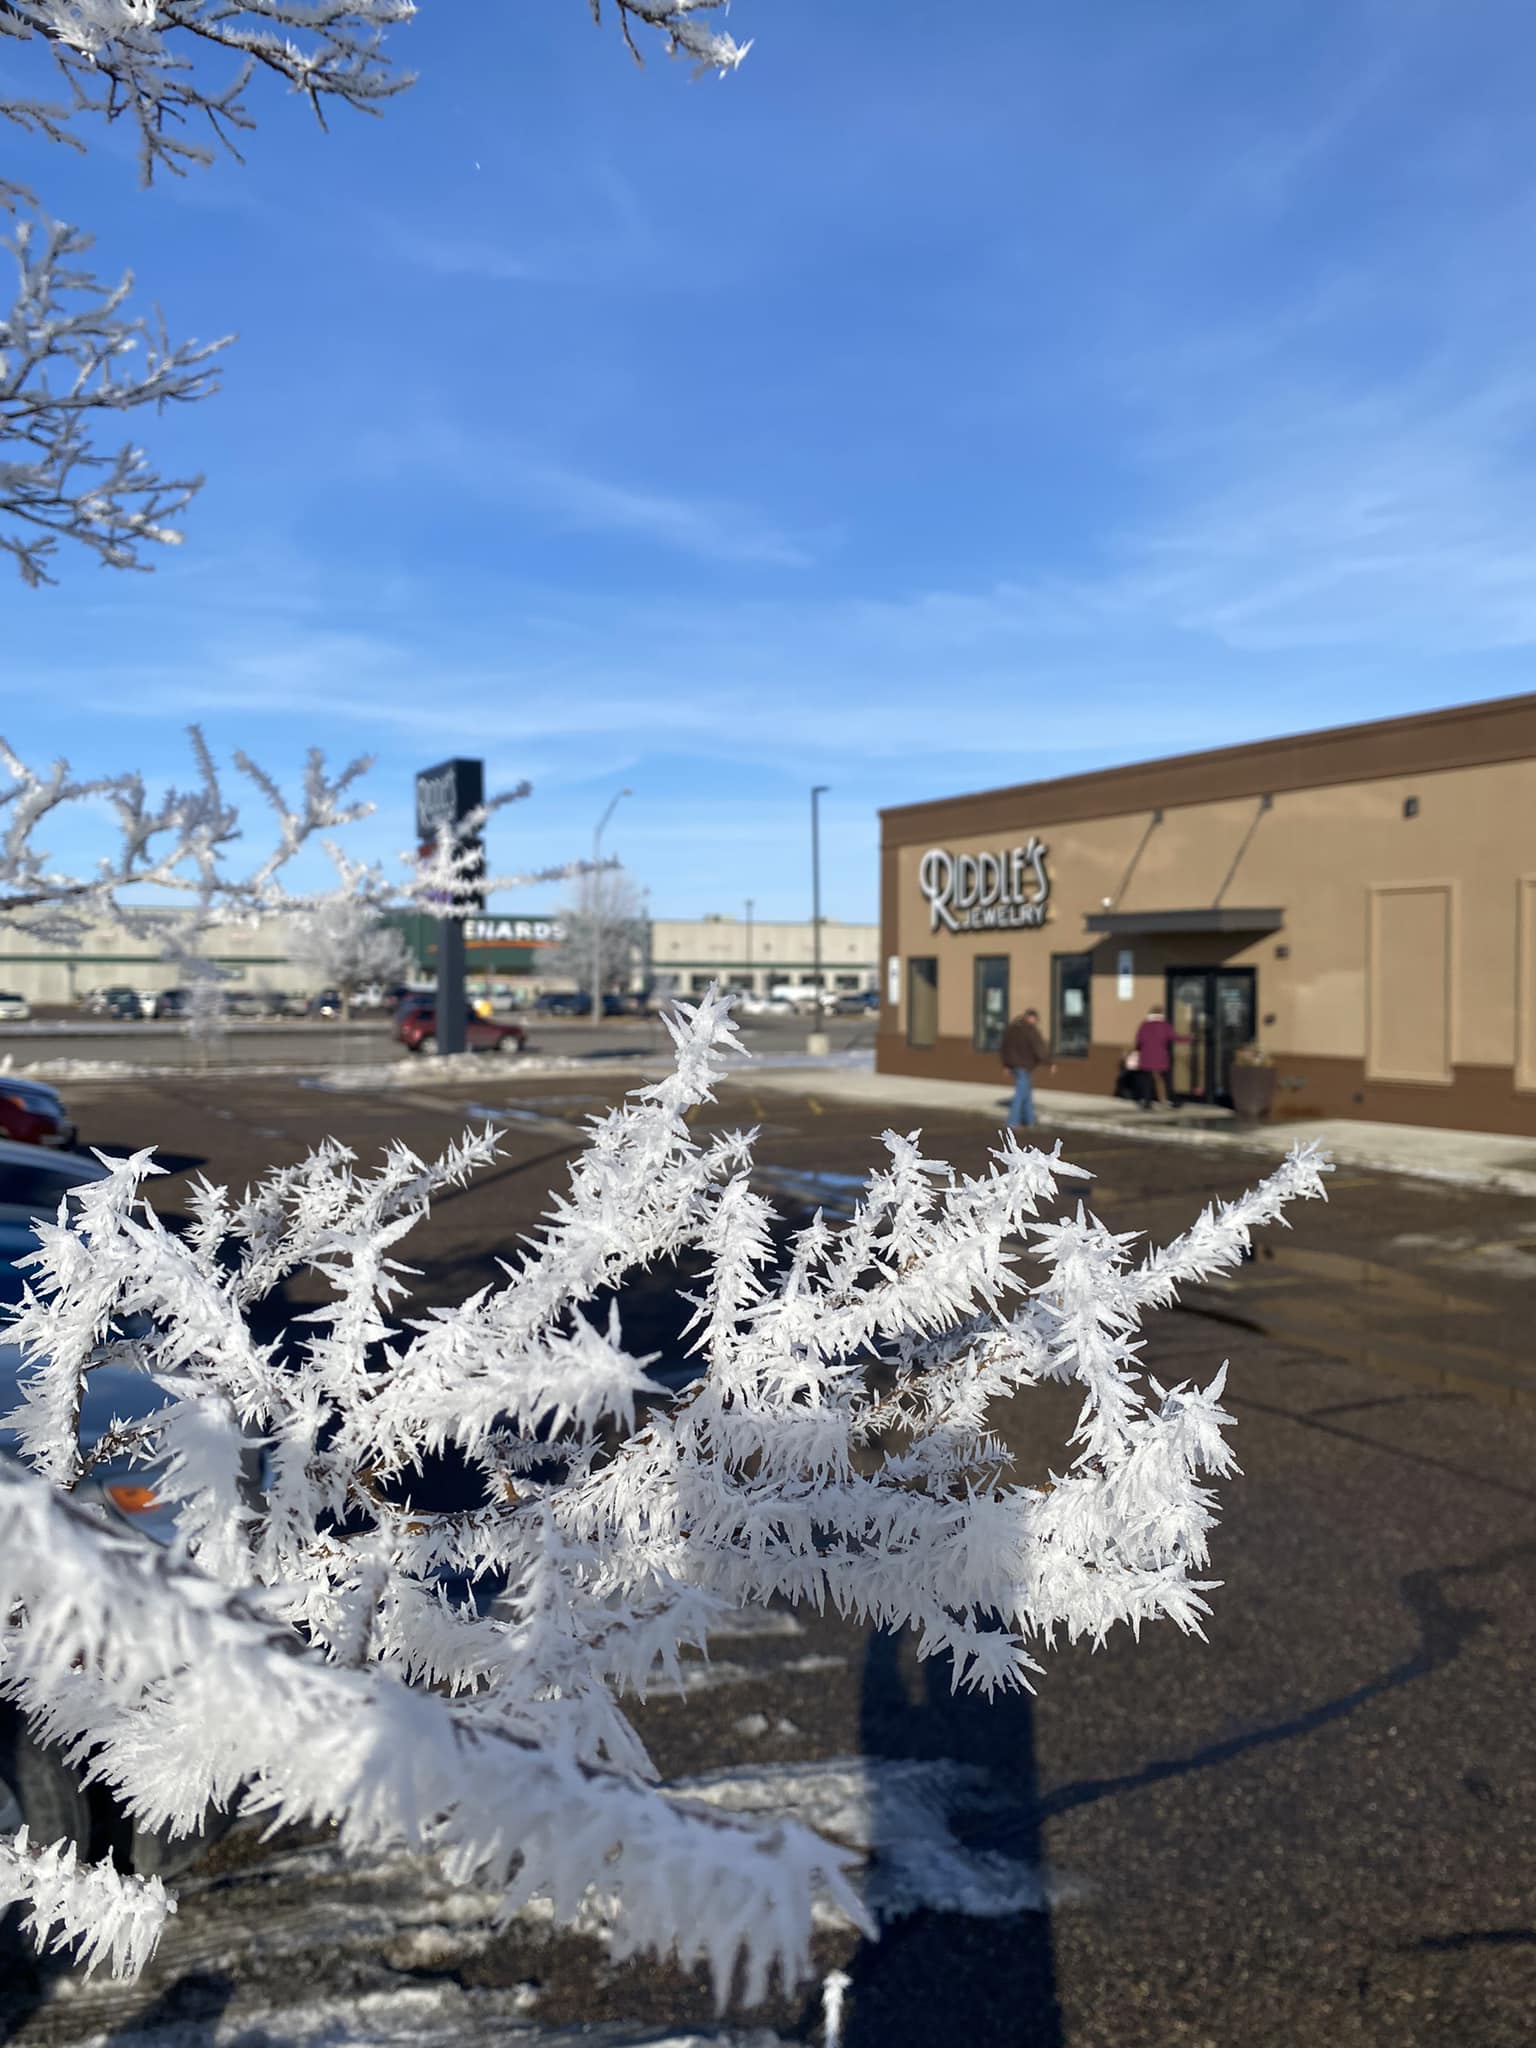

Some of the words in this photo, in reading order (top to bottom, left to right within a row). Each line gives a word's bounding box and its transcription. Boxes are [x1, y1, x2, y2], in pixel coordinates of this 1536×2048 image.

[920, 837, 1048, 930] RIDDLE'S
[964, 904, 1045, 928] JEWELRY
[463, 919, 567, 940] ENARDS
